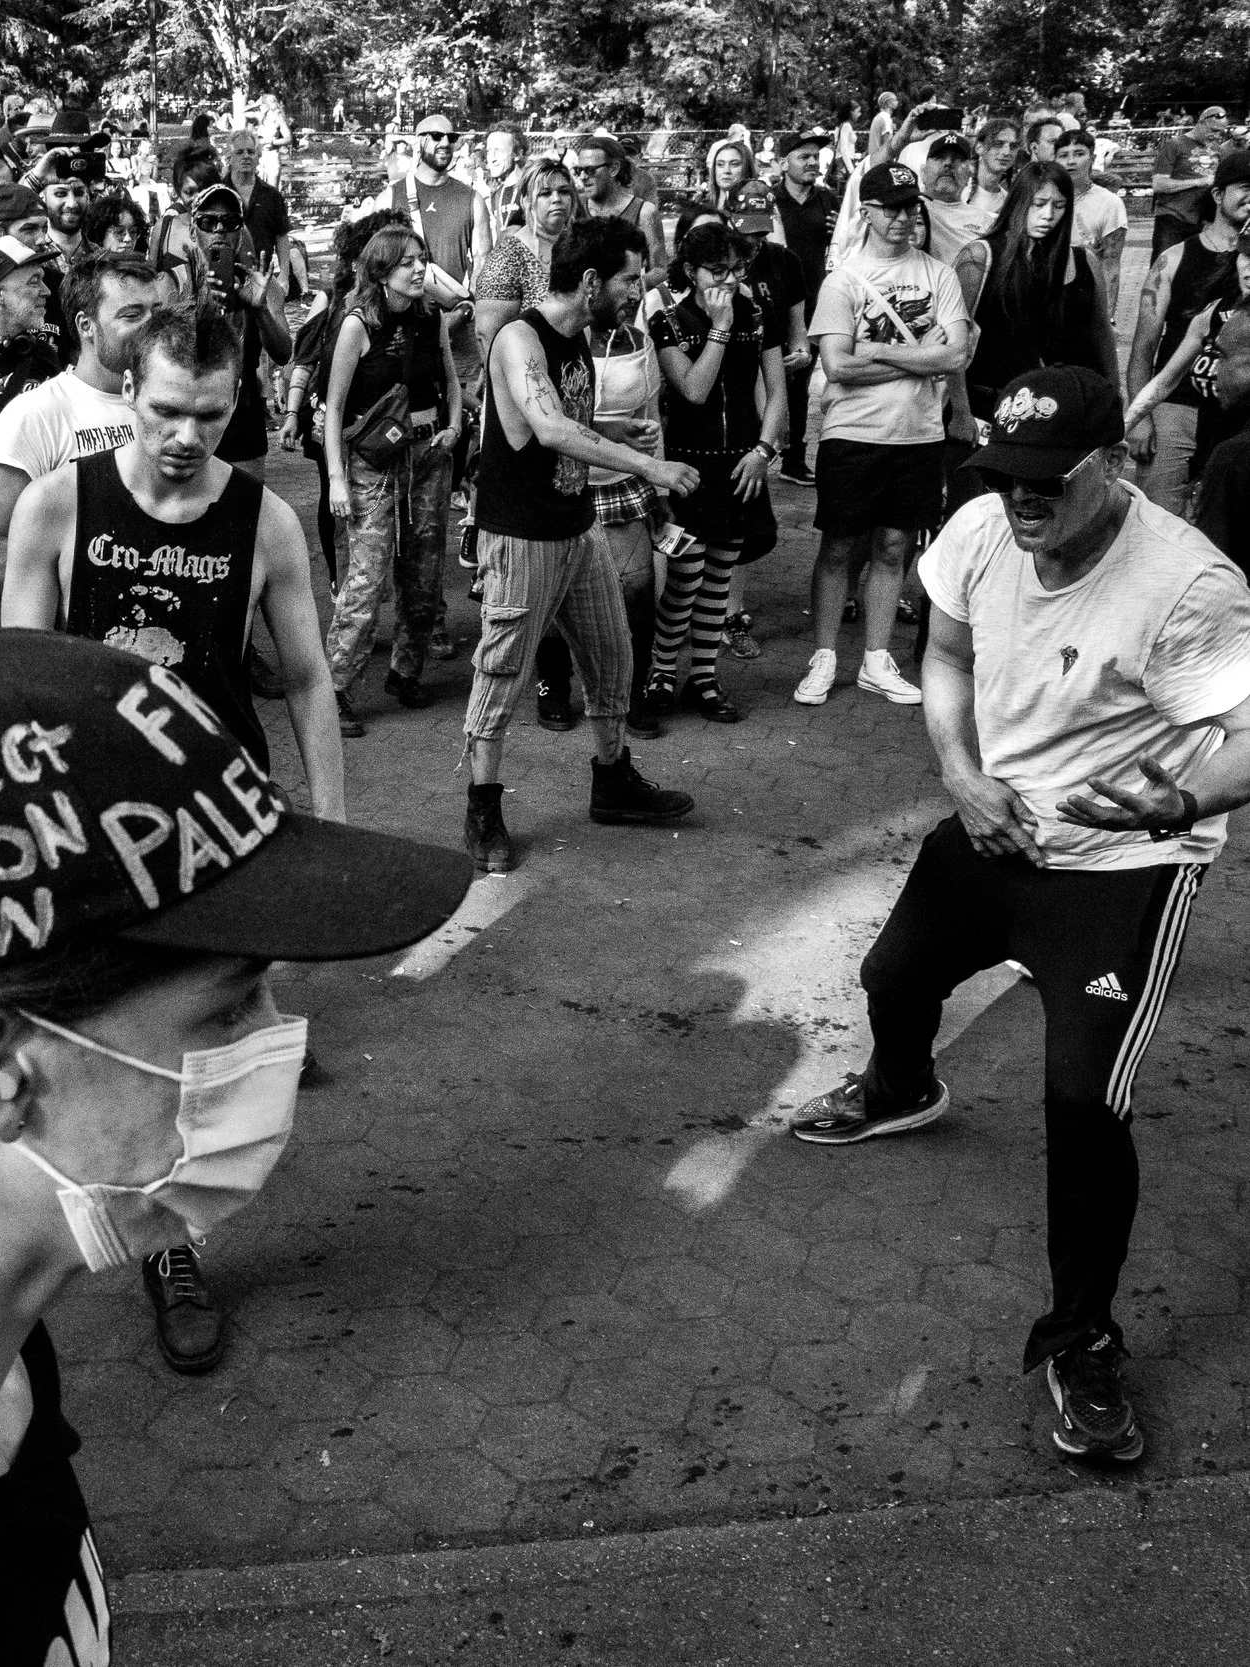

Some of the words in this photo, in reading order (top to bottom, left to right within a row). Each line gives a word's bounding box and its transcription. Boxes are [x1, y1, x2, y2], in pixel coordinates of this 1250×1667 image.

[87, 533, 232, 584] Cro-Mags
[99, 755, 286, 910] PALE
[1085, 985, 1129, 1002] adidas
